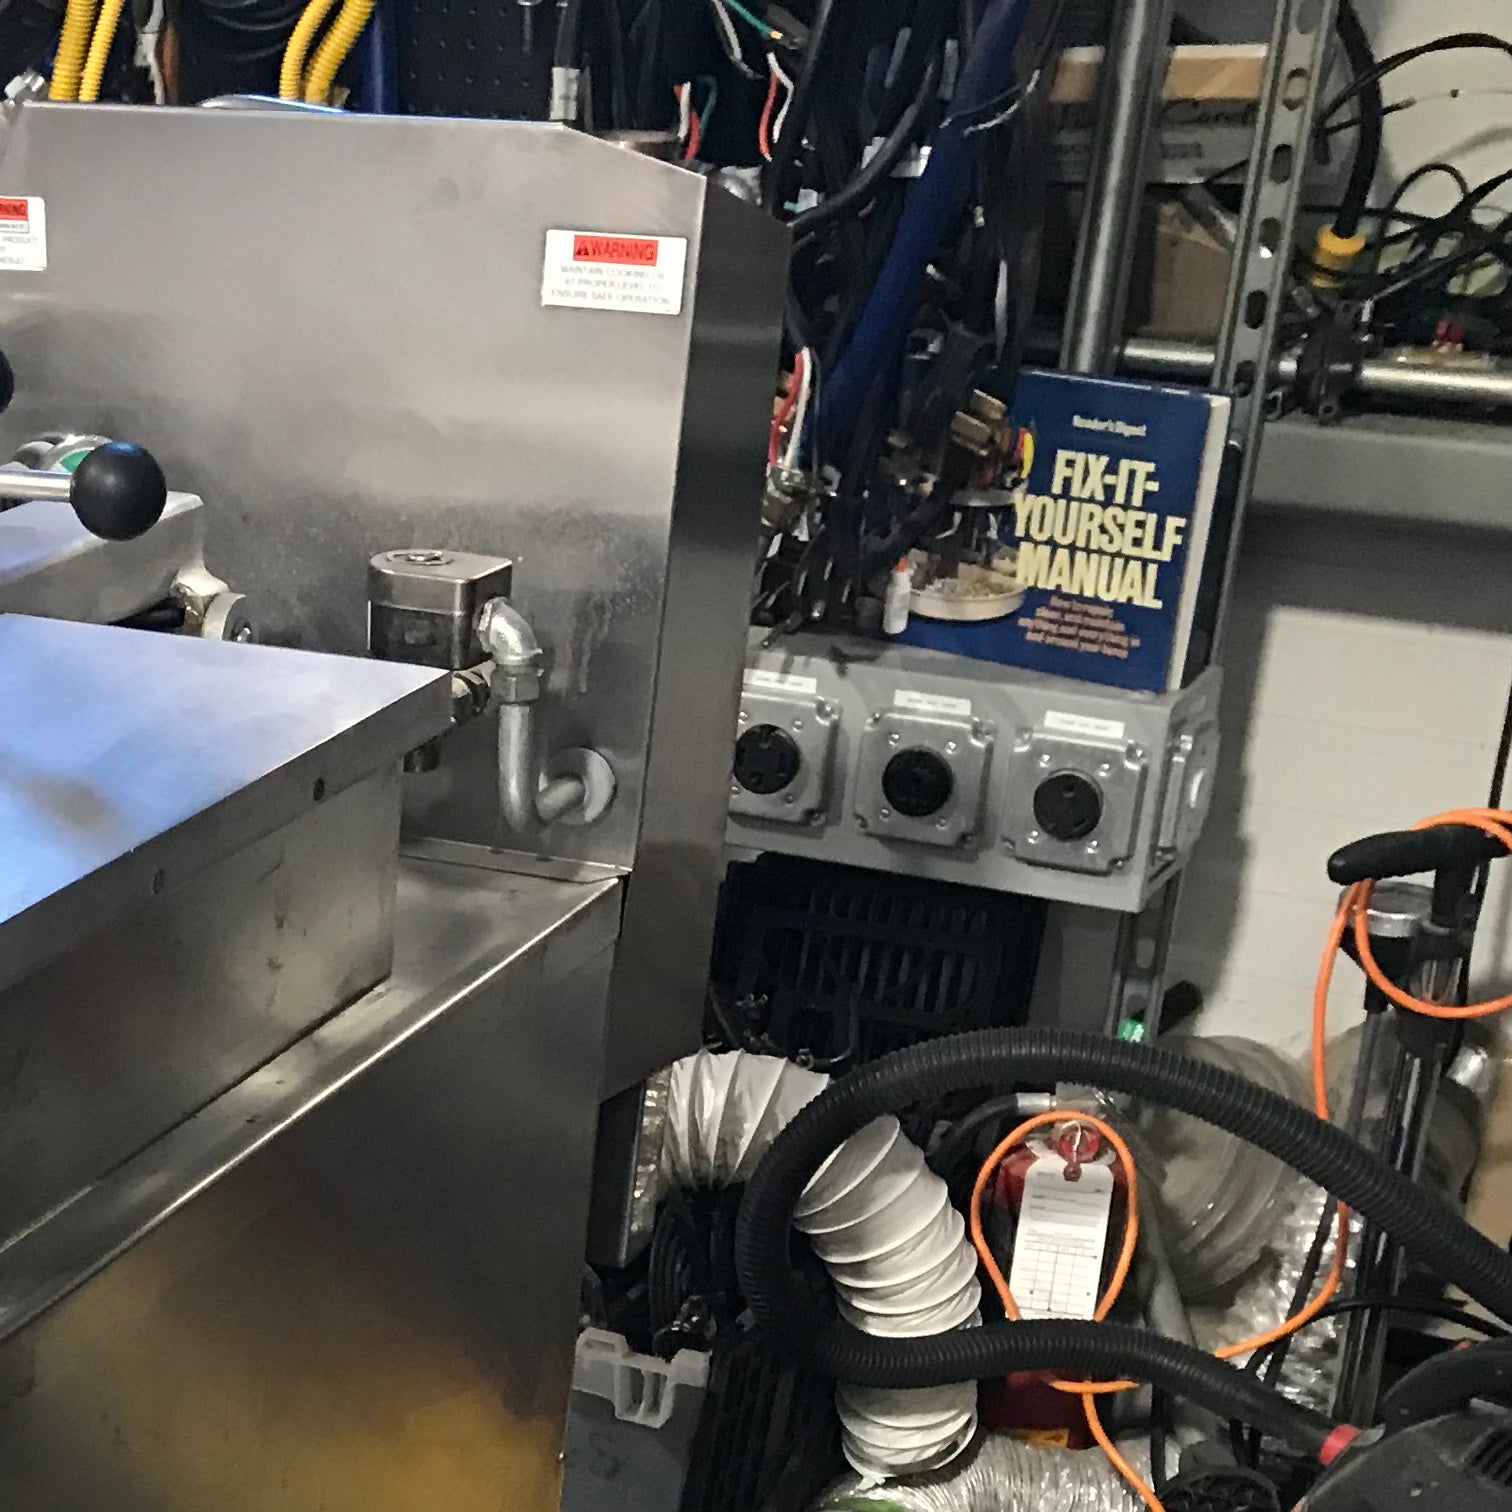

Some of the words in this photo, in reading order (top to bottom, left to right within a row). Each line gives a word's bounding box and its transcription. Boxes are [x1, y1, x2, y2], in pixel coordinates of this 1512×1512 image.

[591, 240, 655, 261] WARNING
[1051, 449, 1159, 508] FIX-IT-
[1012, 491, 1186, 562] YOURSELF
[1016, 540, 1162, 609] MANUAL
